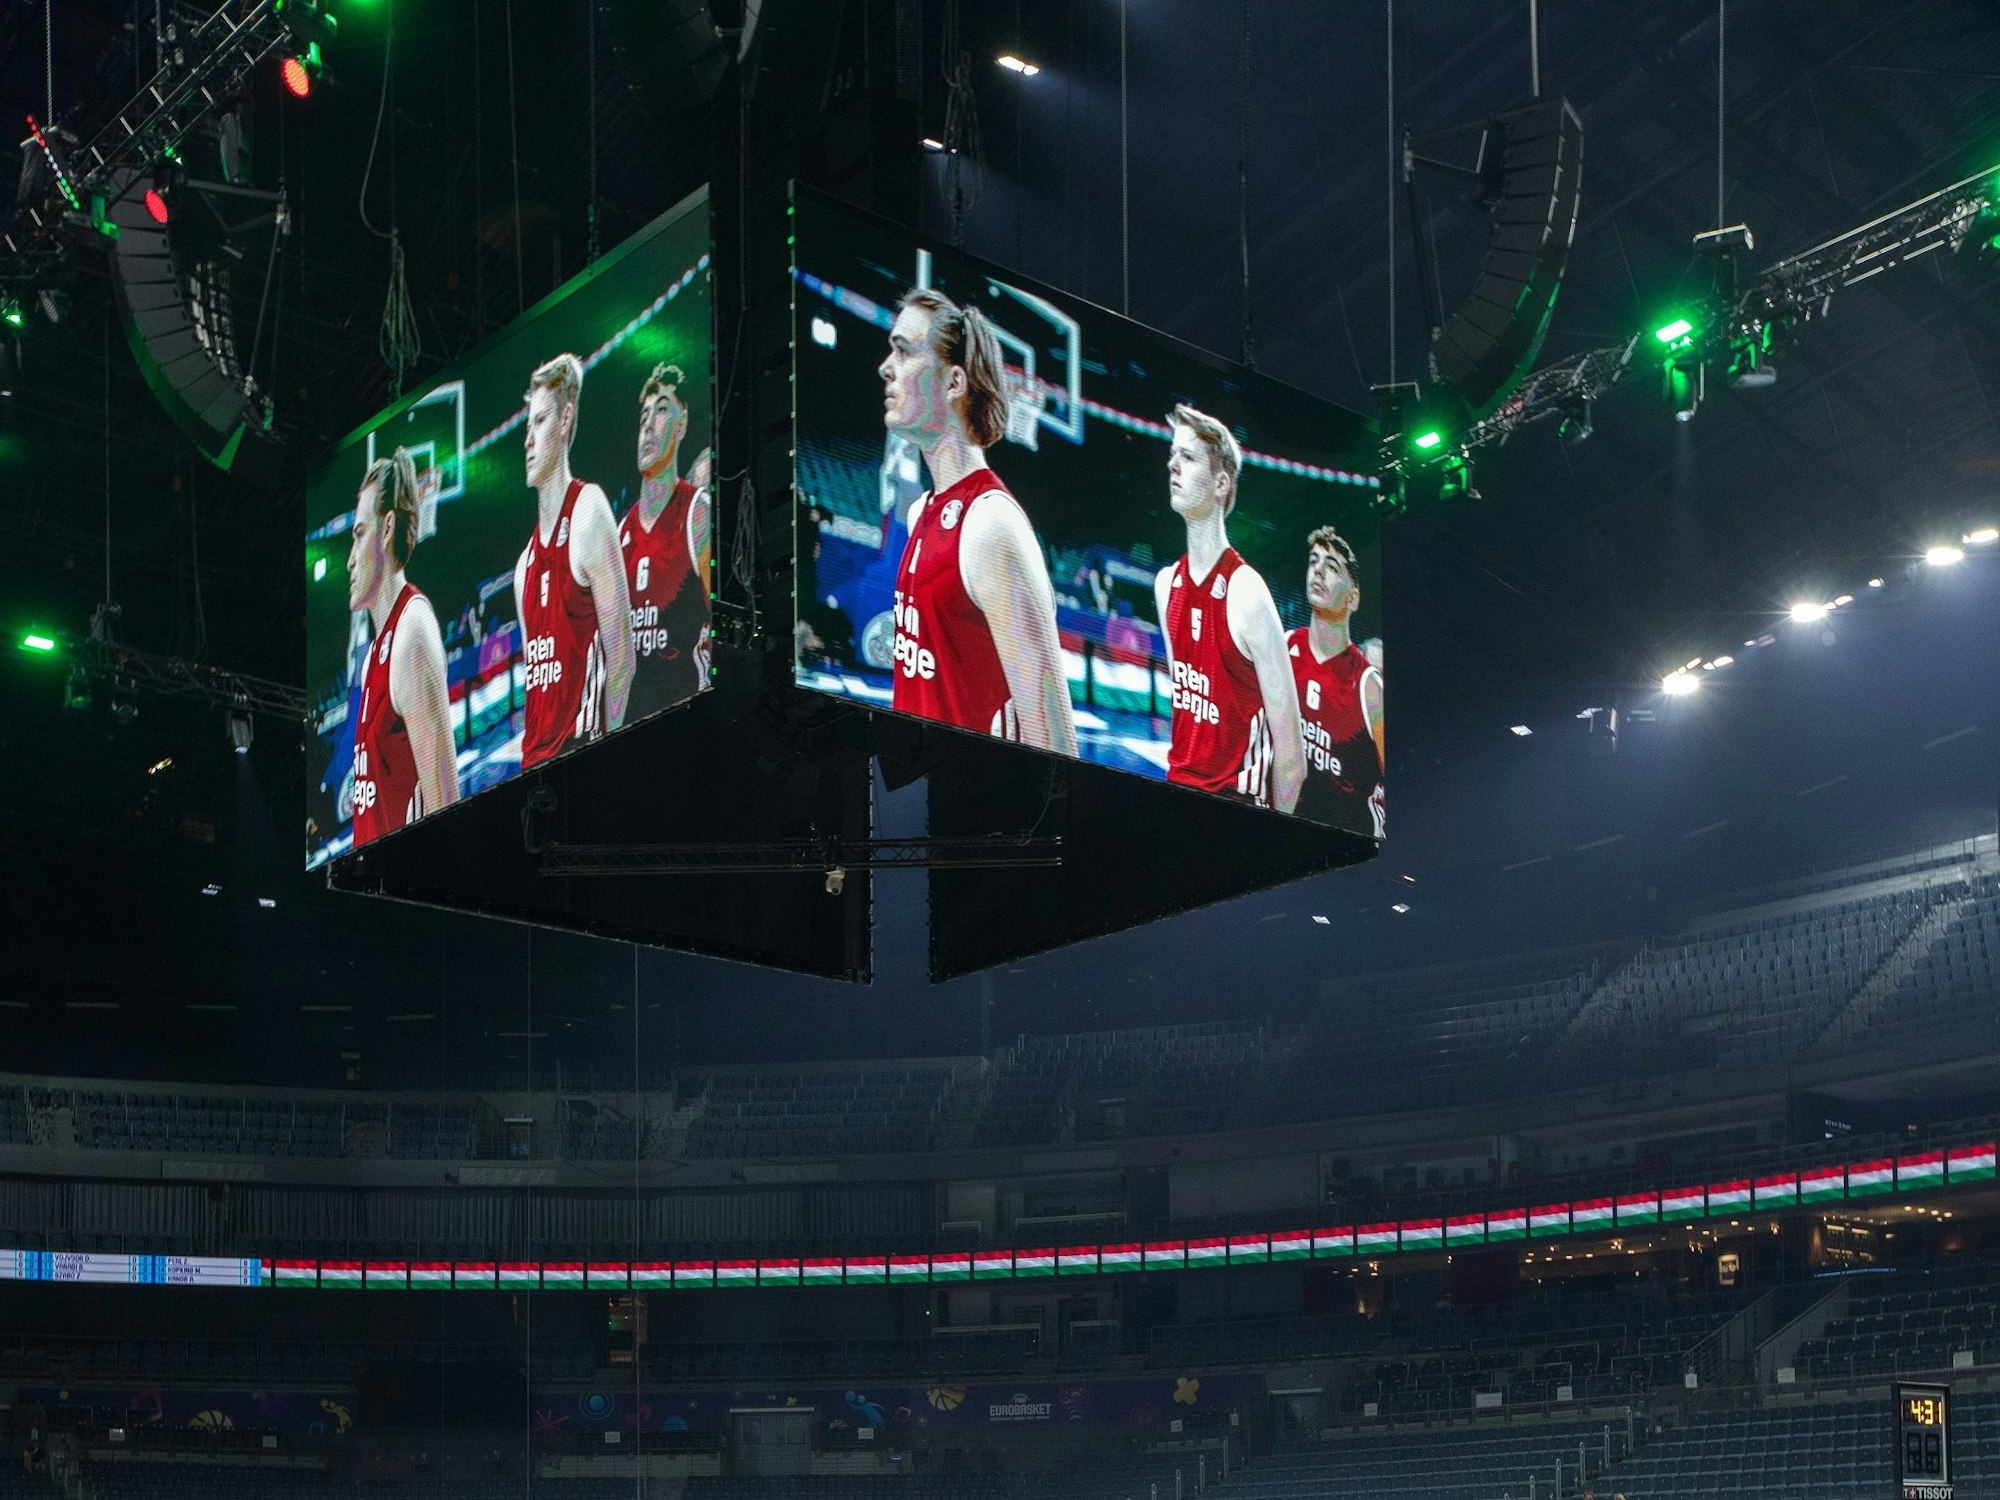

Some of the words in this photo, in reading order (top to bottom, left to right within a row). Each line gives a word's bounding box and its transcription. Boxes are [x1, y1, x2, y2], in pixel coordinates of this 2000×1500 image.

[540, 570, 550, 607] 5
[635, 556, 650, 592] 6
[1190, 607, 1203, 642] 5
[1306, 679, 1322, 711] 6
[989, 1403, 1051, 1416] EUROBASKET
[1910, 1399, 1942, 1425] 4:31
[1917, 1486, 1953, 1500] TISSOT
